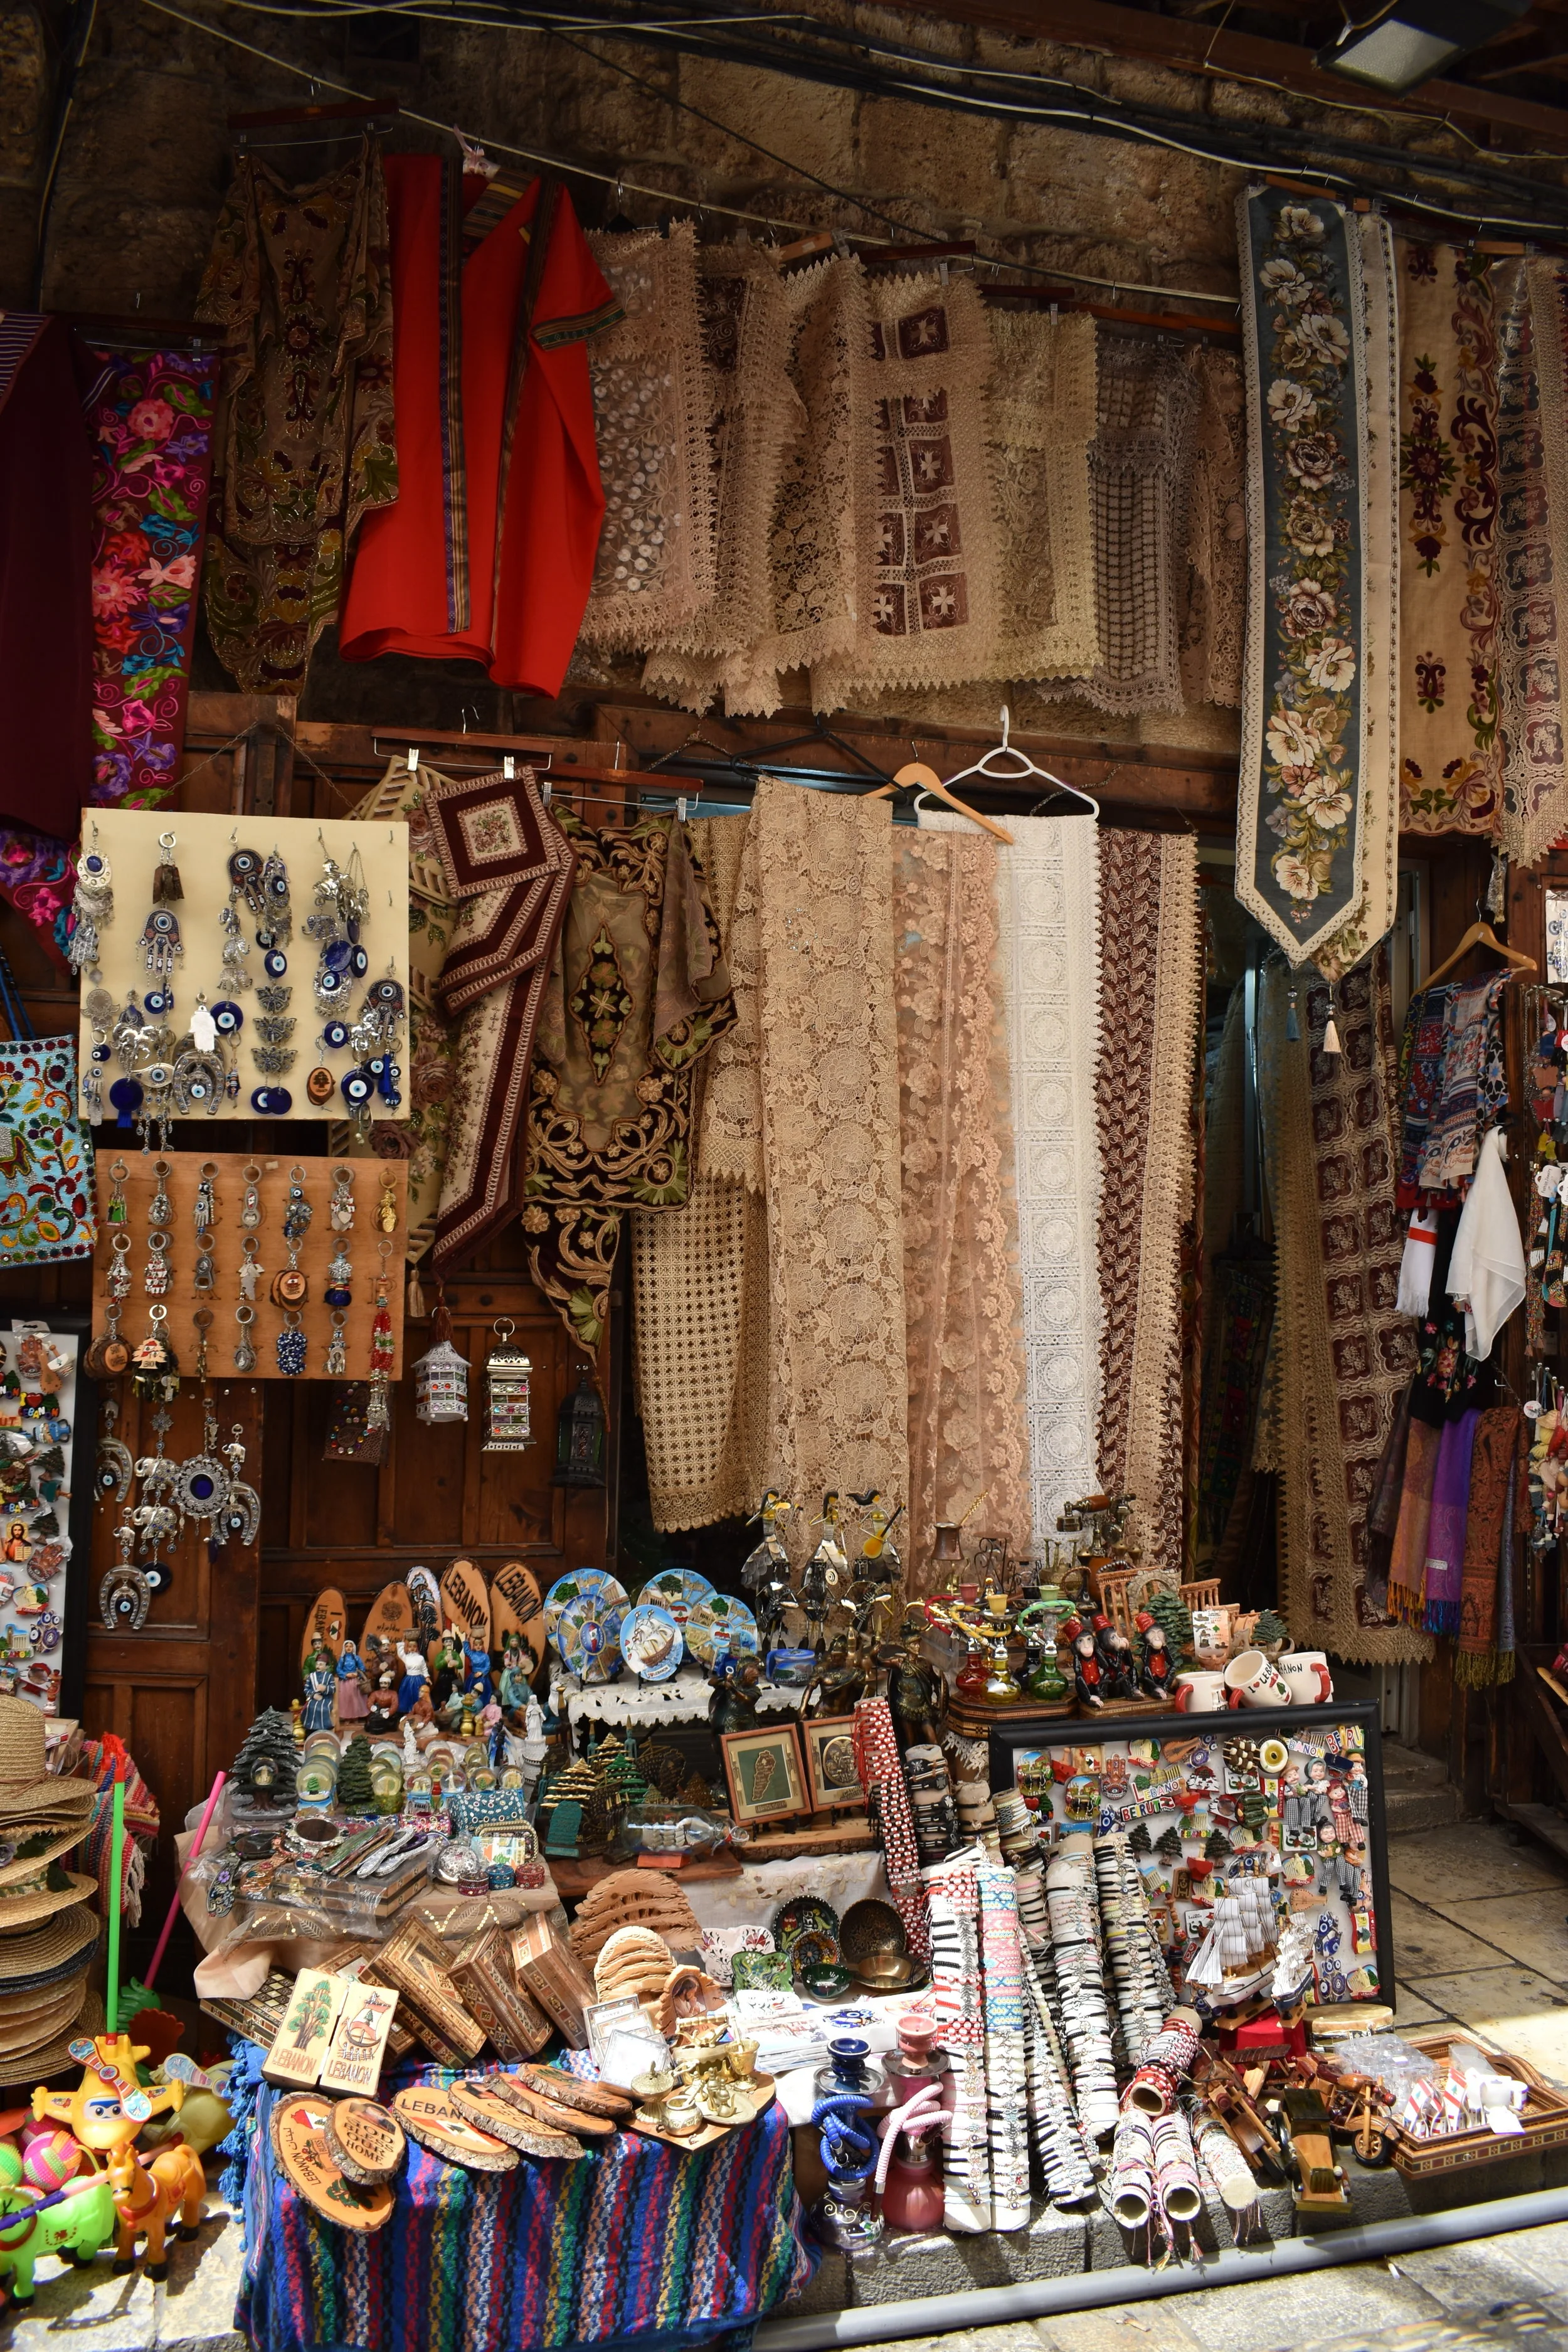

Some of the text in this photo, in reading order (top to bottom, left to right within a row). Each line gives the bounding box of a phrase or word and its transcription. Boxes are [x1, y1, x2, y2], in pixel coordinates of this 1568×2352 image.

[18, 1406, 60, 1420] LEBANON
[444, 1570, 488, 1629] LEBANON
[494, 1565, 543, 1624] LEBANON
[0, 1650, 31, 1658] EBANON
[1325, 1725, 1365, 1754] BERUT
[1137, 1758, 1154, 1768] LEBANON
[1131, 1780, 1180, 1804] LEBANO
[1121, 1799, 1161, 1822] BEIRUT
[1180, 1830, 1212, 1838] LEBANON
[272, 2047, 317, 2077] LEBANON
[327, 2060, 374, 2085] LEBANON
[344, 2122, 395, 2153] BLESS
[346, 2116, 395, 2144] GOD
[346, 2140, 383, 2165] HOME
[347, 2132, 389, 2158] OUR
[290, 2152, 322, 2186] LEBANON
